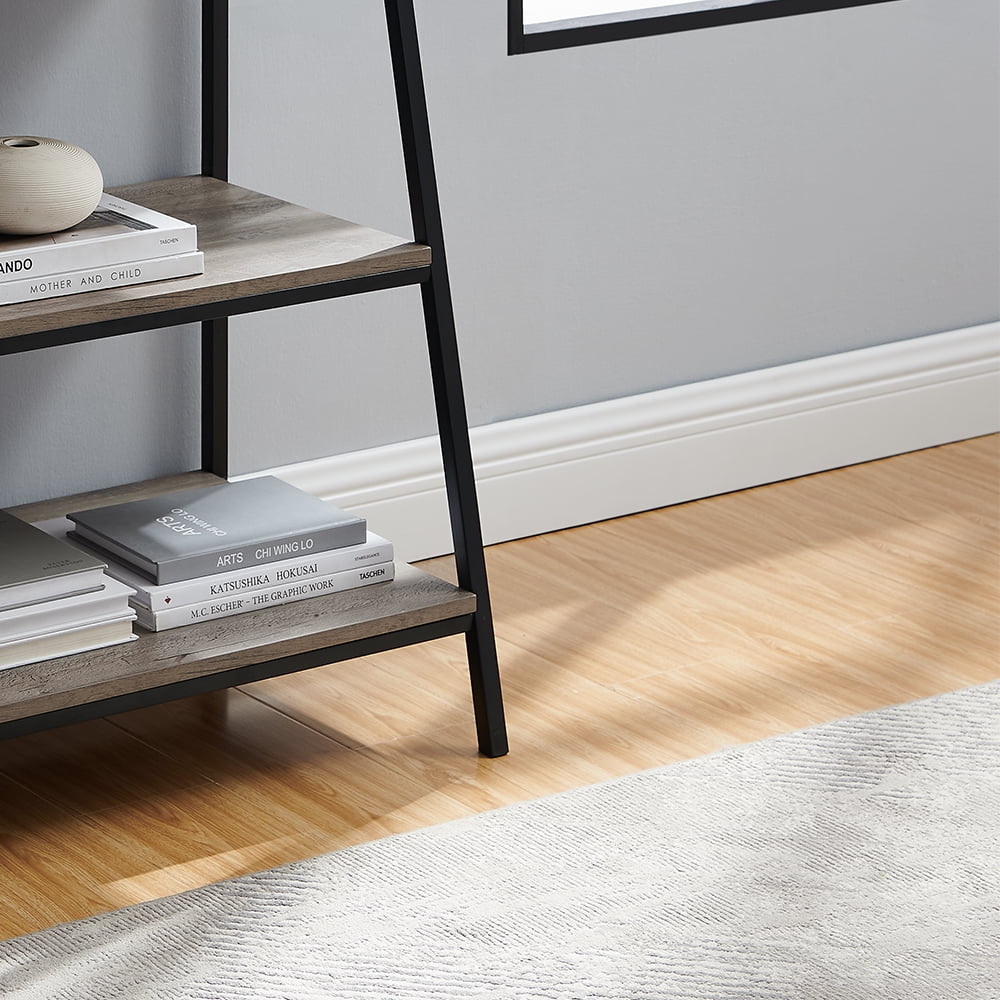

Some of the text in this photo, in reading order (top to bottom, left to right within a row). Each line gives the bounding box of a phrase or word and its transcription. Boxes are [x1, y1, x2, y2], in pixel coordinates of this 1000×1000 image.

[30, 268, 142, 294] MOTHER AND CHILD
[156, 516, 202, 535] ARTS
[217, 552, 244, 568] ARTS
[255, 538, 314, 560] CHI WING LO
[210, 564, 319, 595] KATSUSHIKA HOKUSAI
[360, 569, 385, 580] TASCHEN
[191, 607, 209, 619] M.C.
[252, 593, 269, 605] THE
[270, 584, 307, 602] GRAPHIC
[309, 579, 335, 593] WORK
